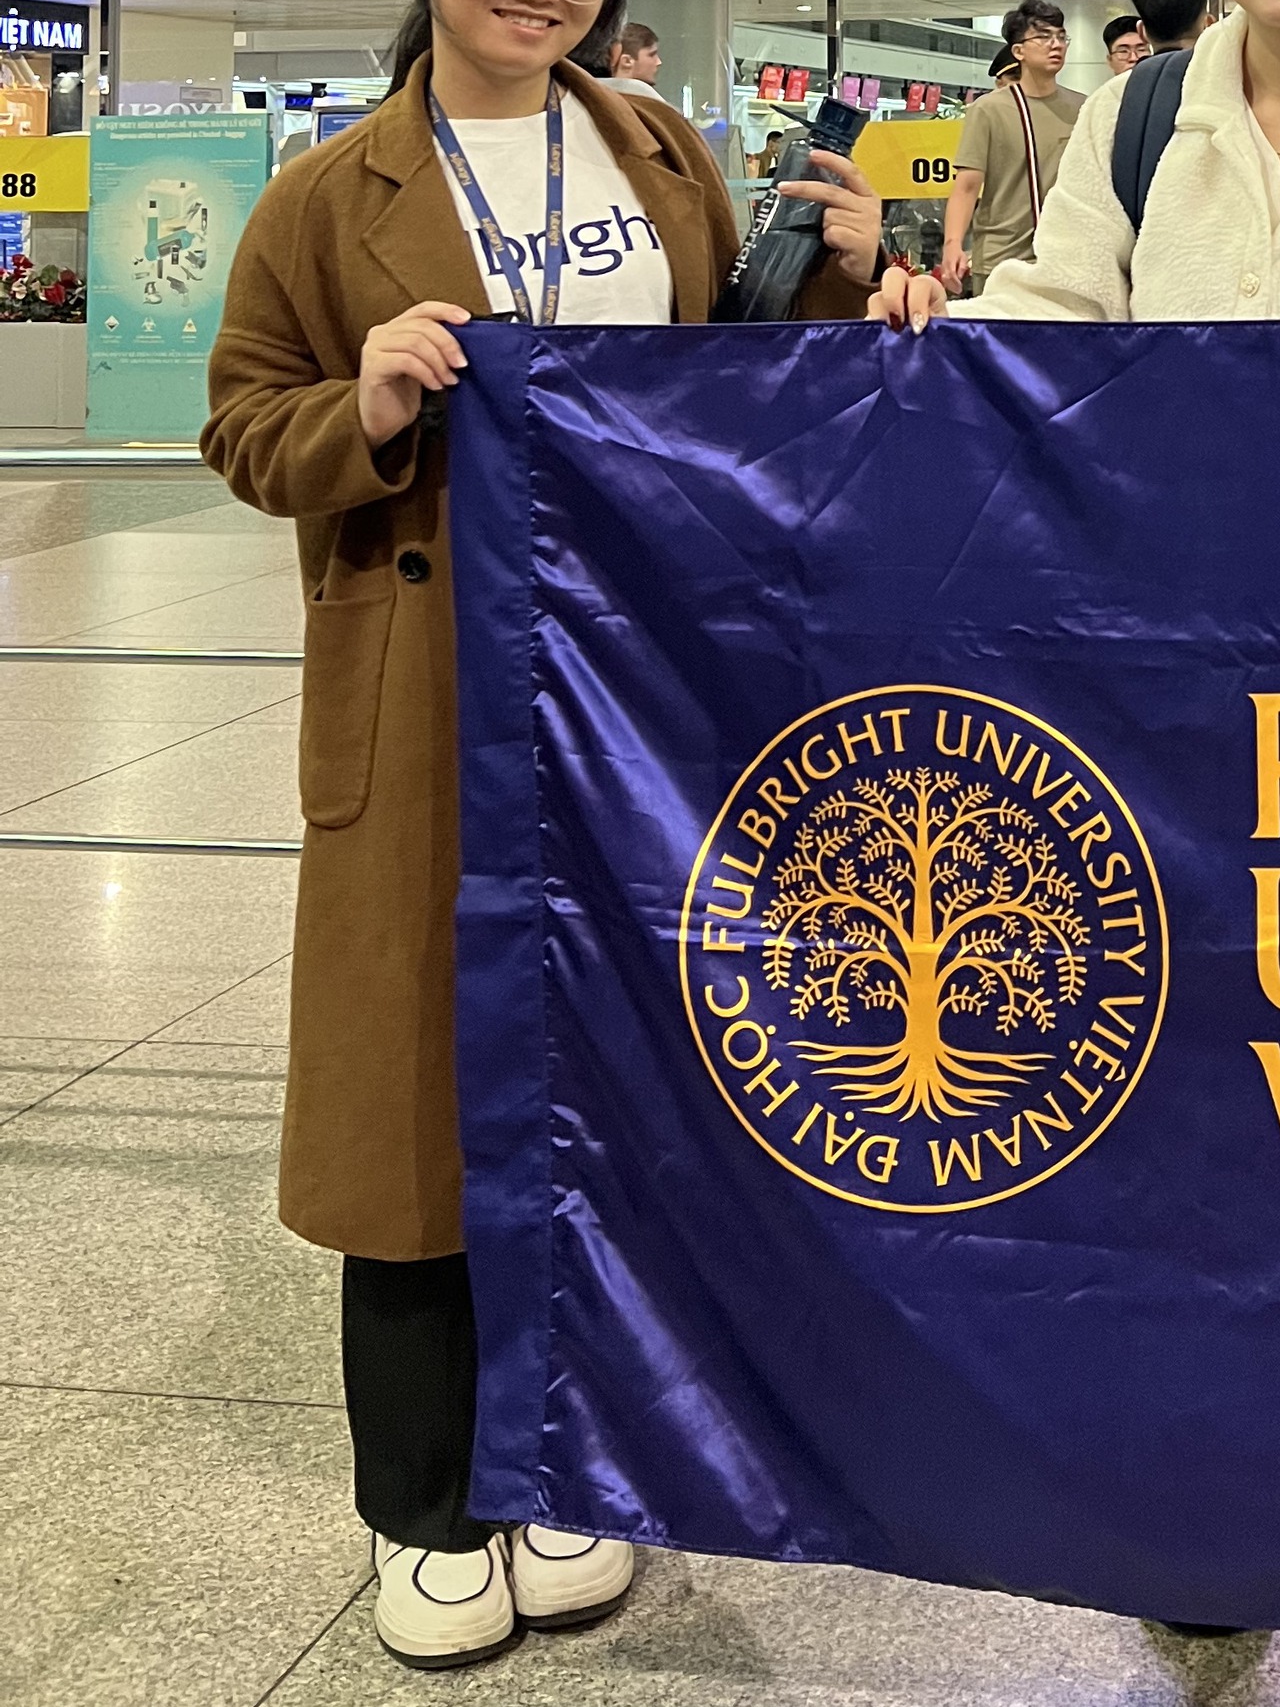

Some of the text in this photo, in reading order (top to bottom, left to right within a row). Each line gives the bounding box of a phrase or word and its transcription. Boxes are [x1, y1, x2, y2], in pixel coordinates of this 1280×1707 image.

[33, 20, 82, 49] NAM
[912, 158, 958, 184] 09
[702, 707, 1149, 1187] ĐẠI HỌC FULBRIGHT UNIVERSITY VIỆT NAM
